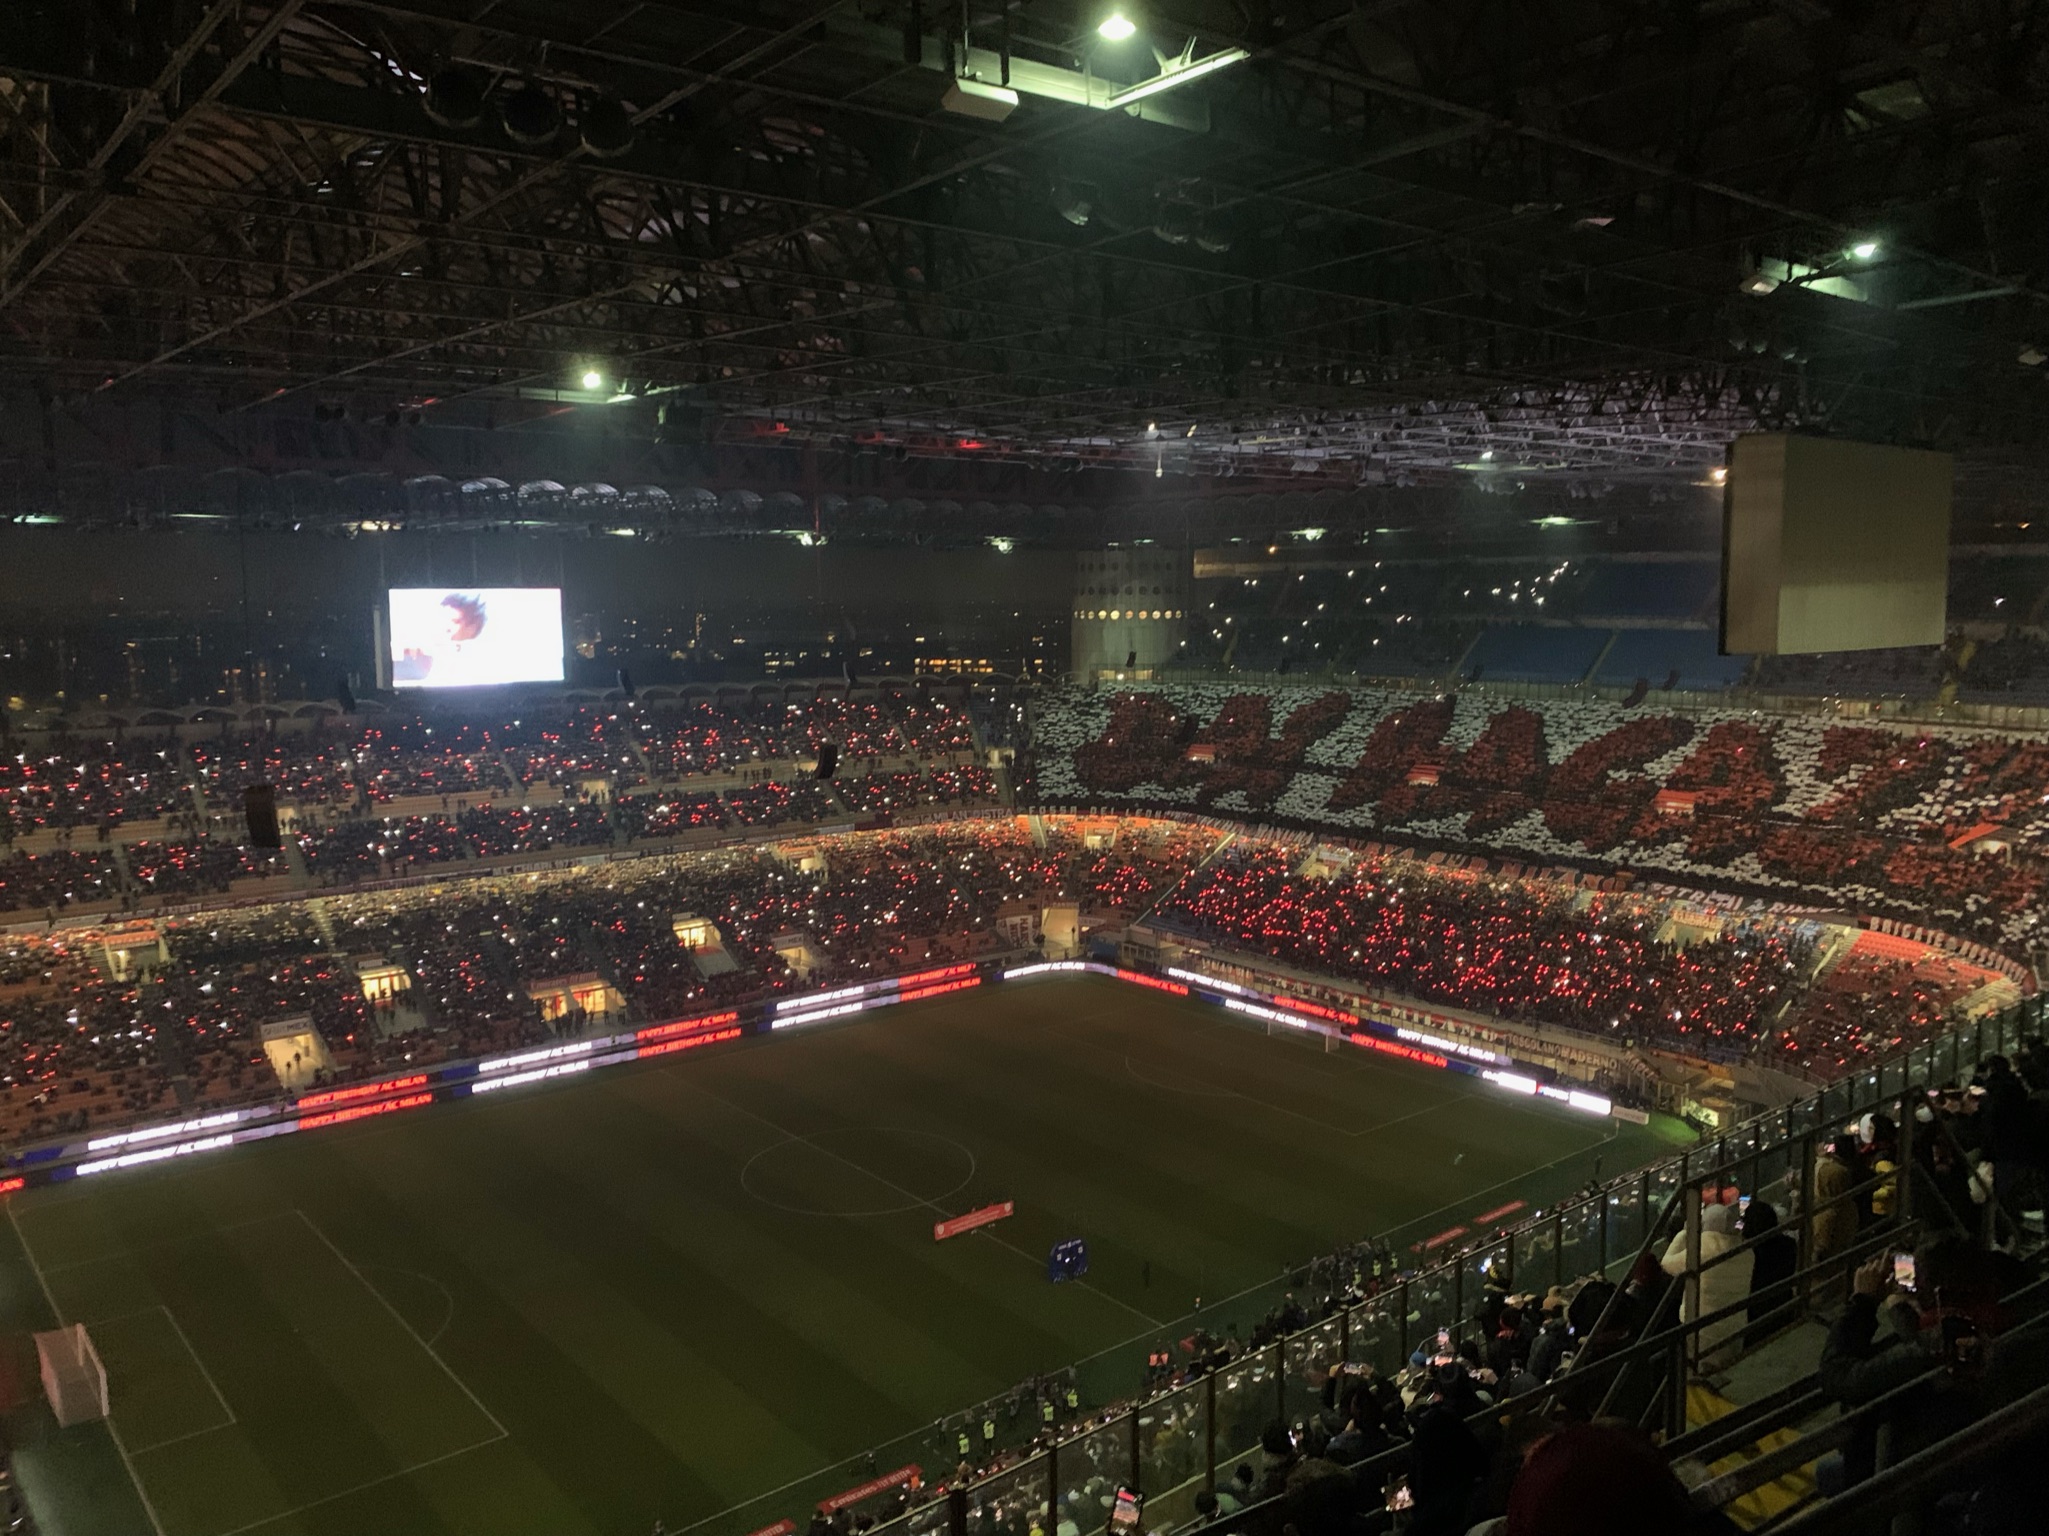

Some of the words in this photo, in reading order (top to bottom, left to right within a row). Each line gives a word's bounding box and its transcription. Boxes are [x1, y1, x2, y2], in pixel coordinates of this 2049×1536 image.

[638, 1044, 665, 1058] HAPPY
[666, 1036, 702, 1052] BIRTHDAY
[702, 1034, 715, 1044] AC
[714, 1027, 742, 1041] MILAN
[1351, 1033, 1375, 1047] HAPPY
[1375, 1039, 1410, 1057] BIRTHDAY
[1410, 1050, 1421, 1061] AC
[1421, 1053, 1447, 1068] MILAN
[298, 1093, 334, 1109] HAPPY
[333, 1084, 380, 1102] BIRTHDAY
[380, 1081, 398, 1094] AC
[398, 1074, 428, 1090] MILAN
[299, 1113, 336, 1130] HAPPY
[335, 1102, 384, 1123] BIRTHDAY
[383, 1100, 400, 1114] AC
[400, 1092, 433, 1111] MILAN
[829, 1485, 878, 1509] Emirates
